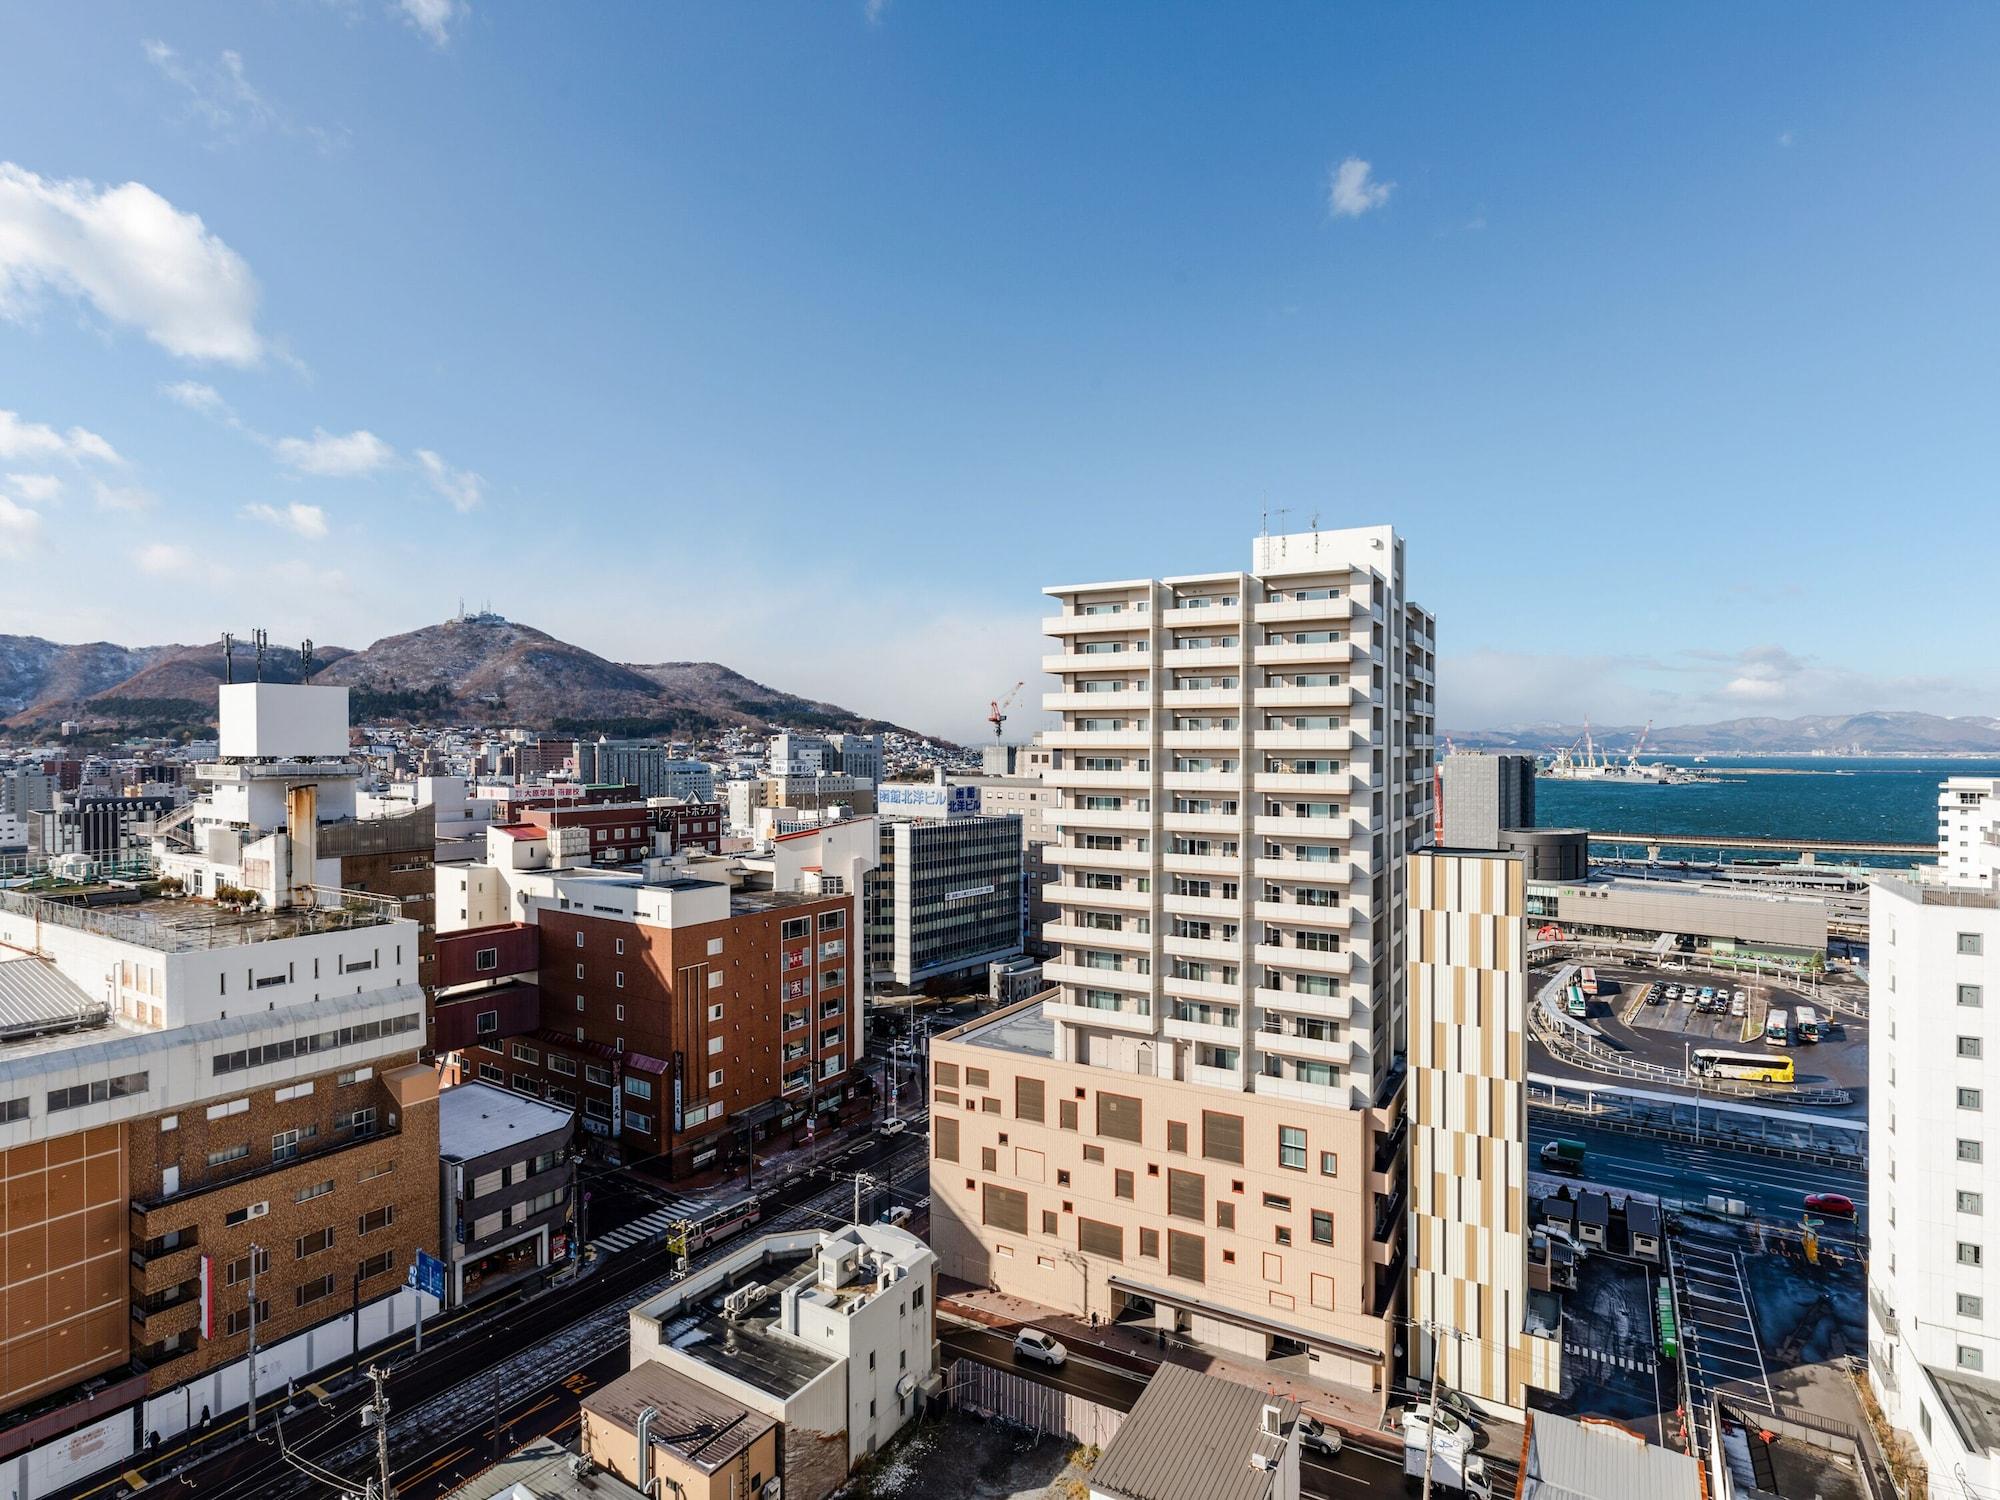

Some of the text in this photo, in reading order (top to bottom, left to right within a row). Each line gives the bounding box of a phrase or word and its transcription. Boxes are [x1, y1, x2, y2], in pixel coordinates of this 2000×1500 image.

[879, 789, 946, 805] 函館北洋ビル
[947, 800, 981, 813] 北洋ビル
